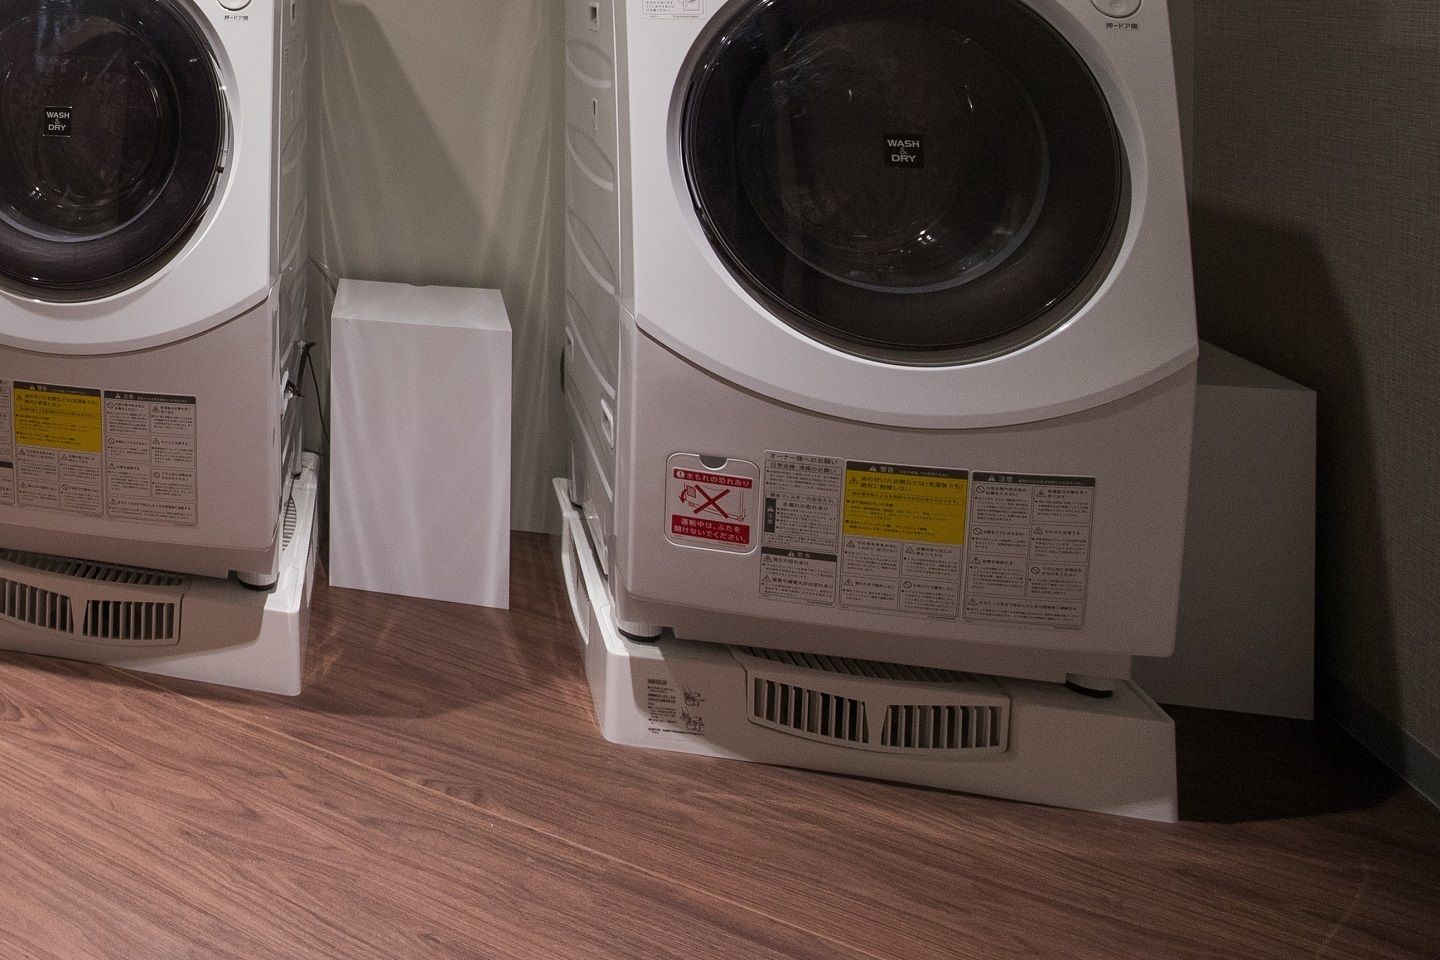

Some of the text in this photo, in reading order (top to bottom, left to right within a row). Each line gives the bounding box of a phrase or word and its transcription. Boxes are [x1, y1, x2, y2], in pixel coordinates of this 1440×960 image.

[46, 111, 70, 119] WASH
[887, 139, 920, 148] WASH
[891, 154, 916, 162] DRY
[770, 453, 838, 465] オーナー様へのお願い
[686, 472, 750, 488] 水もれの恐れあり
